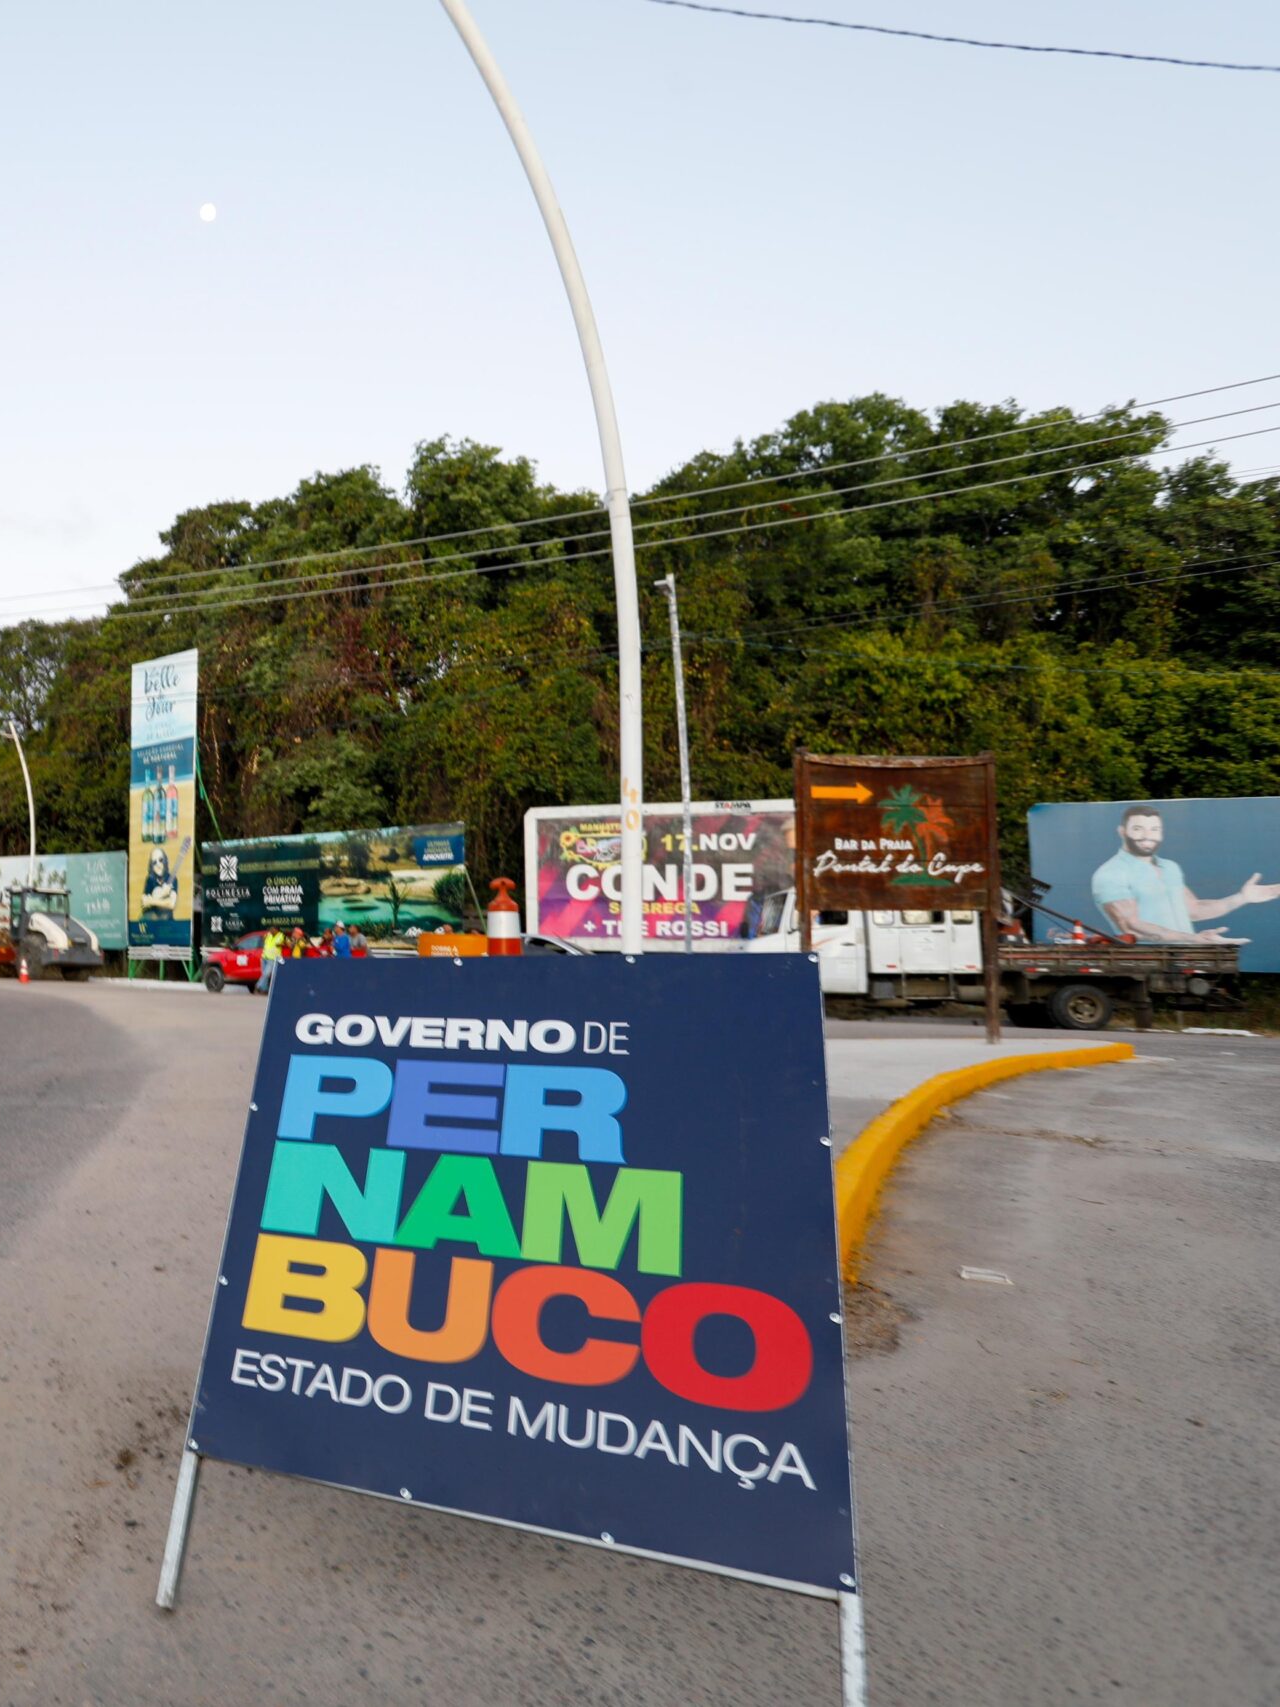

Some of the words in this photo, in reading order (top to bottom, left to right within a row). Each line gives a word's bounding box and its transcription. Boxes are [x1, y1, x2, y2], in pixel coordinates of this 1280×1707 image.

[813, 850, 893, 877] Pontal
[895, 853, 923, 873] do
[927, 852, 985, 884] Cupe
[834, 837, 859, 850] BAR
[861, 839, 877, 850] DA
[879, 838, 913, 850] PRAIA
[656, 920, 728, 937] ROSSI
[294, 1013, 576, 1052] GOVERNO
[582, 1021, 630, 1055] DE
[276, 1053, 628, 1164] PER
[260, 1139, 684, 1277] NAM
[241, 1233, 814, 1412] BUCO
[230, 1348, 413, 1414] ESTADO
[423, 1381, 494, 1432] DE
[507, 1395, 817, 1490] MUDANÇA
